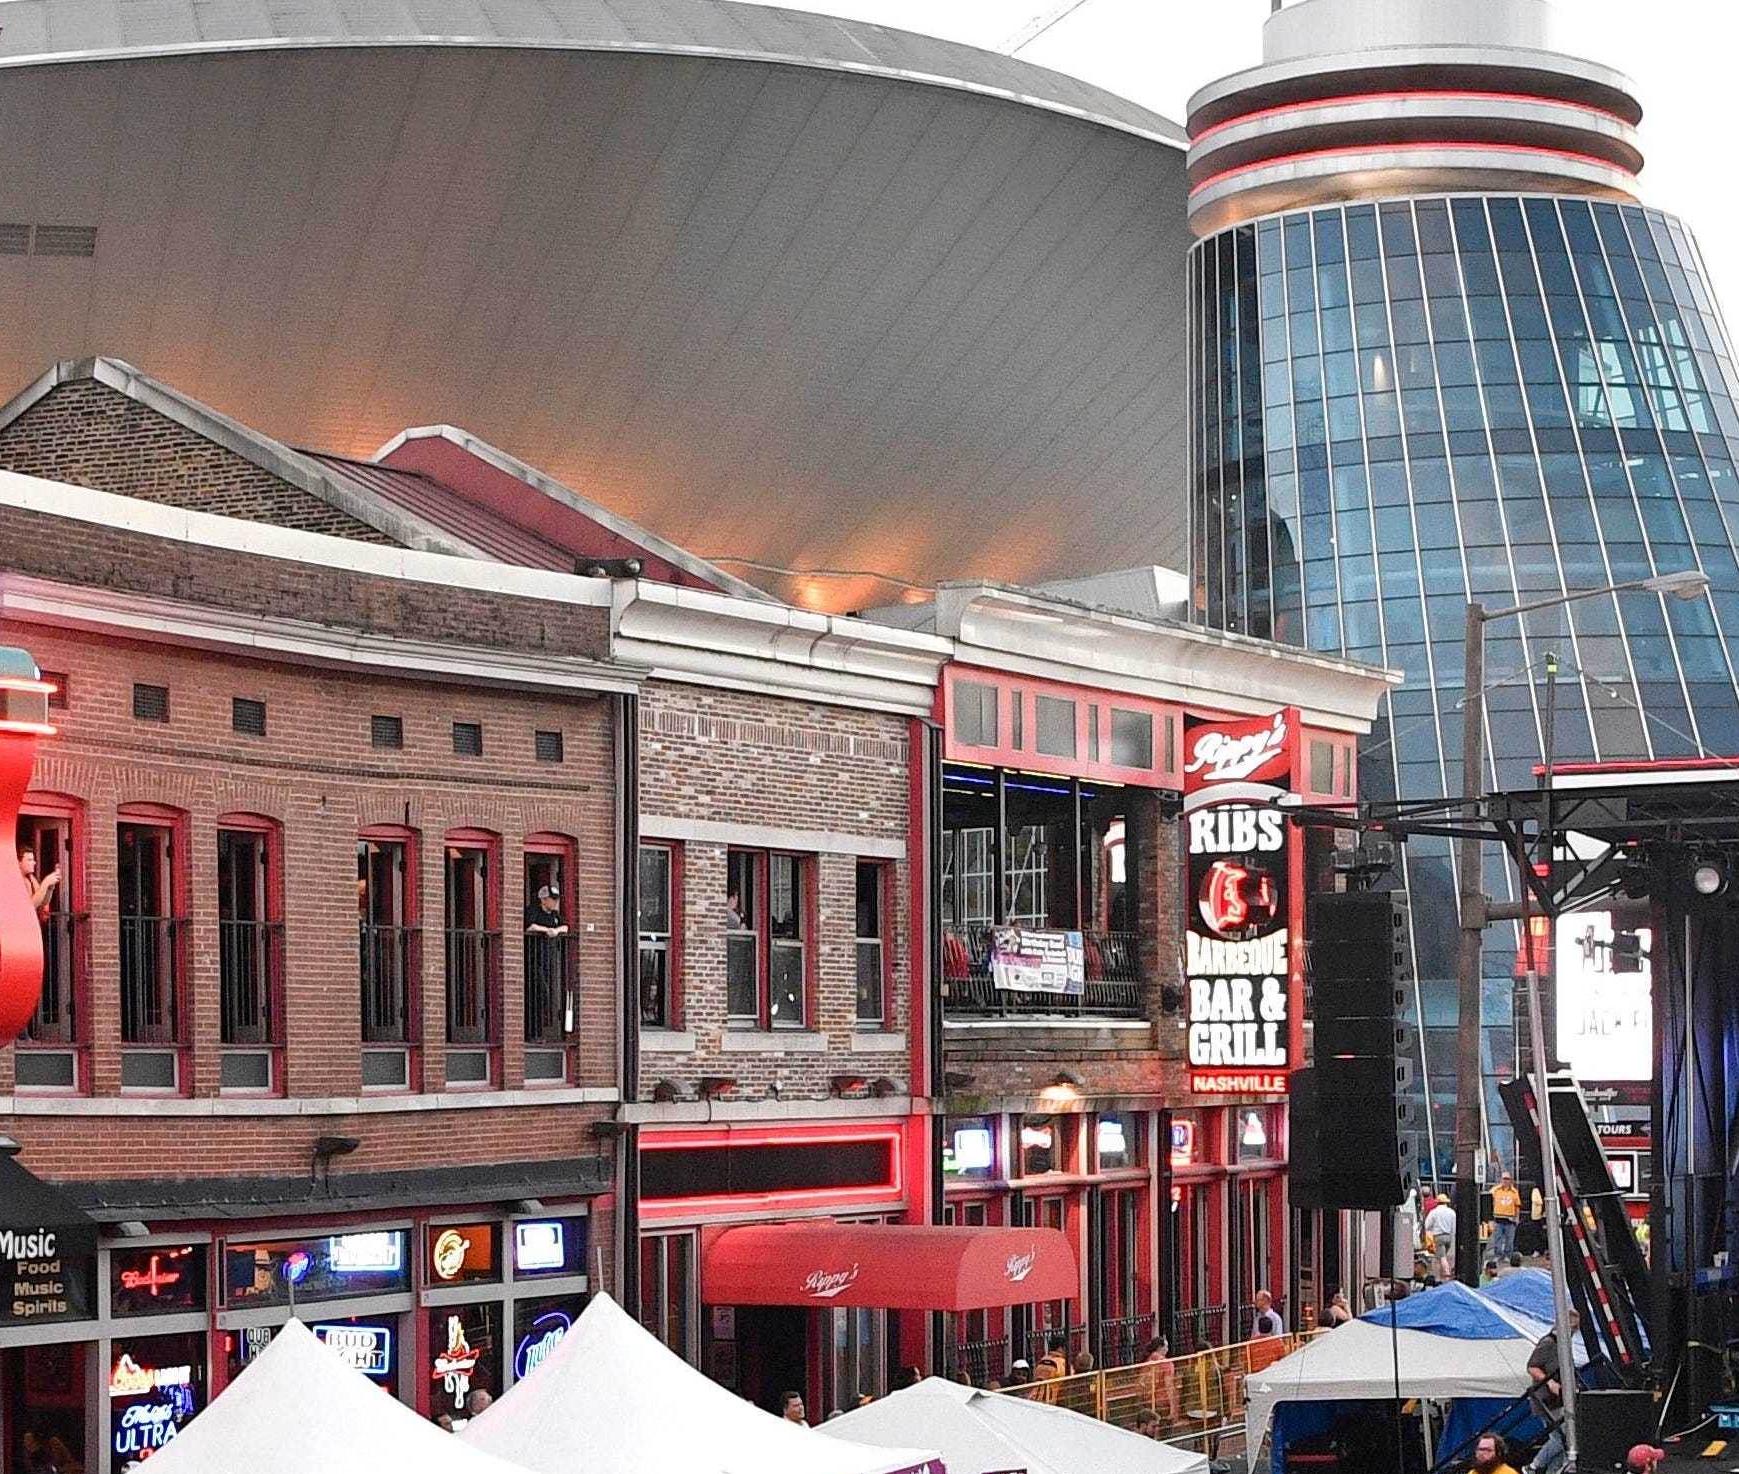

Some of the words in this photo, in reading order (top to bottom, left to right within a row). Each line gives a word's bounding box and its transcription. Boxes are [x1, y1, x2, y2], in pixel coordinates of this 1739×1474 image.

[1184, 713, 1287, 775] Rippy's
[1189, 804, 1284, 854] RIBS
[1186, 928, 1288, 976] BARBEQUE
[1189, 978, 1255, 1022] BAR
[1259, 977, 1287, 1022] &
[1189, 1022, 1286, 1066] GRILL
[1194, 1076, 1285, 1092] NASHVILLE
[16, 1259, 61, 1275] Food
[800, 1262, 859, 1292] Rippy's
[1003, 1244, 1036, 1278] Rippy's
[13, 1280, 65, 1297] Music
[12, 1300, 68, 1318] Spirits
[325, 1330, 378, 1351] BUD
[116, 1420, 179, 1453] ULTRA
